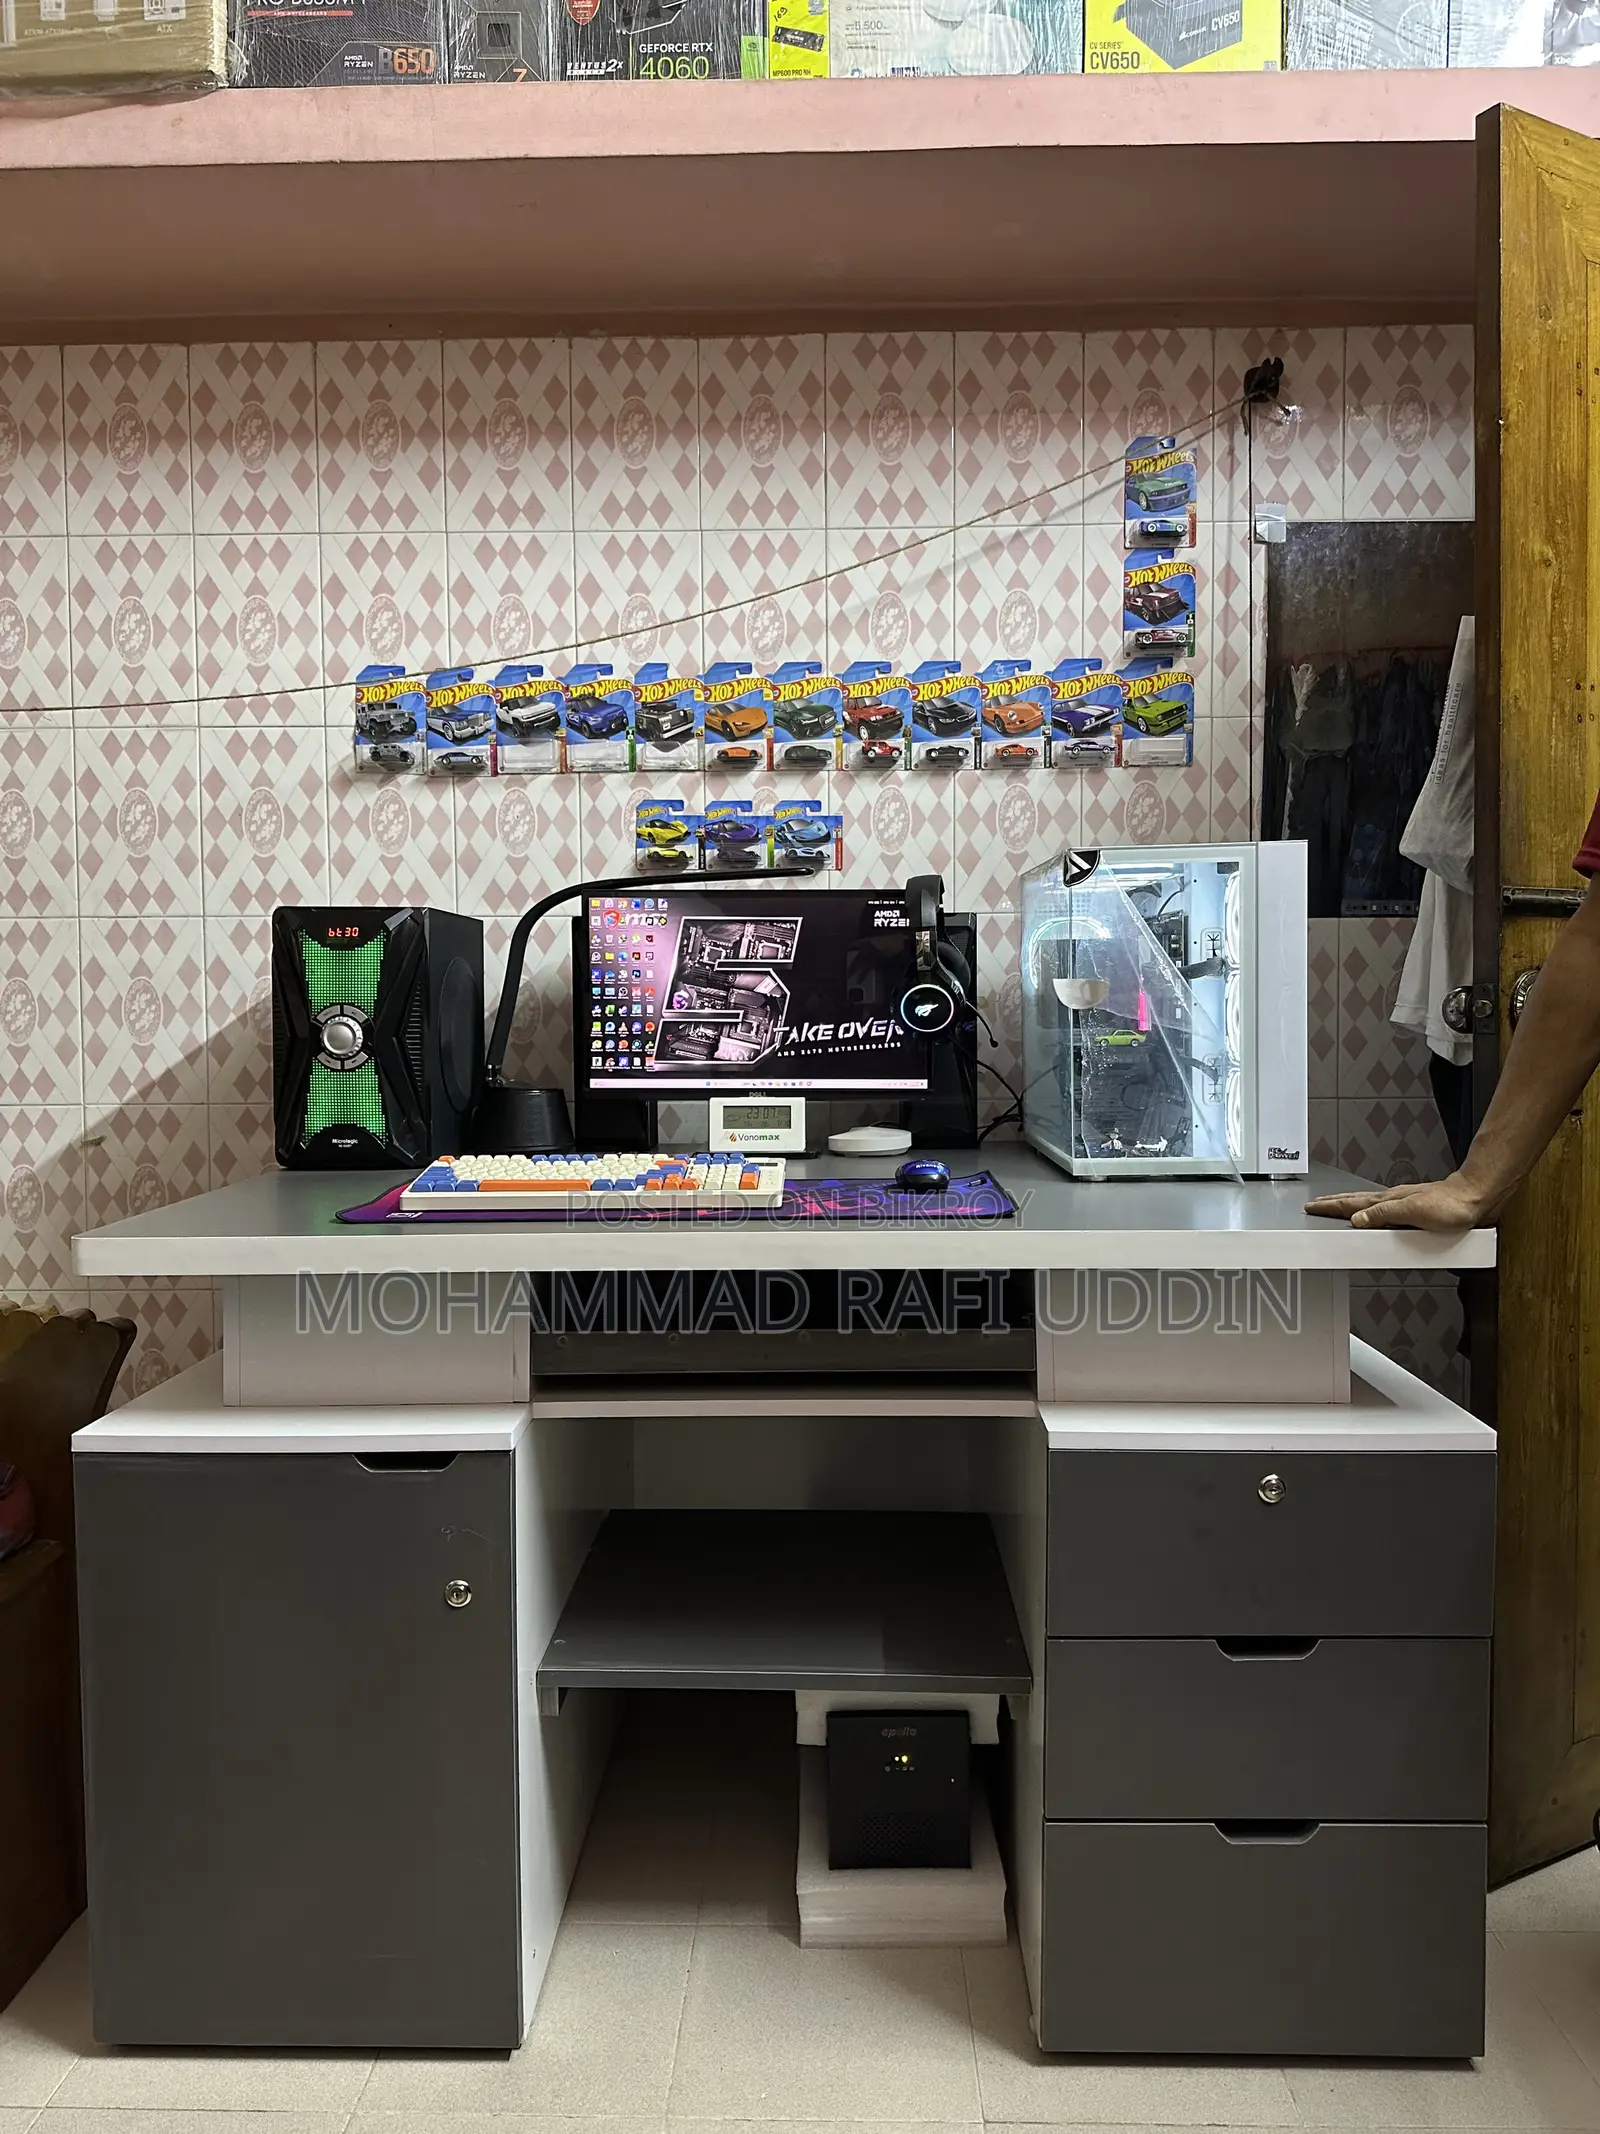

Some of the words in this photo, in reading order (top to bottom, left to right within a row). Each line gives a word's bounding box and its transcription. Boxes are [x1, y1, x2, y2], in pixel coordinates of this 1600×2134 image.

[1211, 10, 1240, 31] CV650
[156, 24, 173, 33] ATX
[639, 42, 689, 53] GEFORCE
[691, 42, 713, 52] RTX
[378, 47, 435, 74] B650
[567, 61, 606, 70] VENTUS
[1090, 51, 1140, 69] CV650
[1554, 56, 1571, 65] Xbo
[639, 56, 710, 79] 4060
[454, 71, 486, 79] RYZEN
[513, 68, 527, 82] 7
[1444, 681, 1462, 736] healthcare
[773, 1022, 834, 1051] TAKE
[737, 1133, 780, 1141] Vonomax
